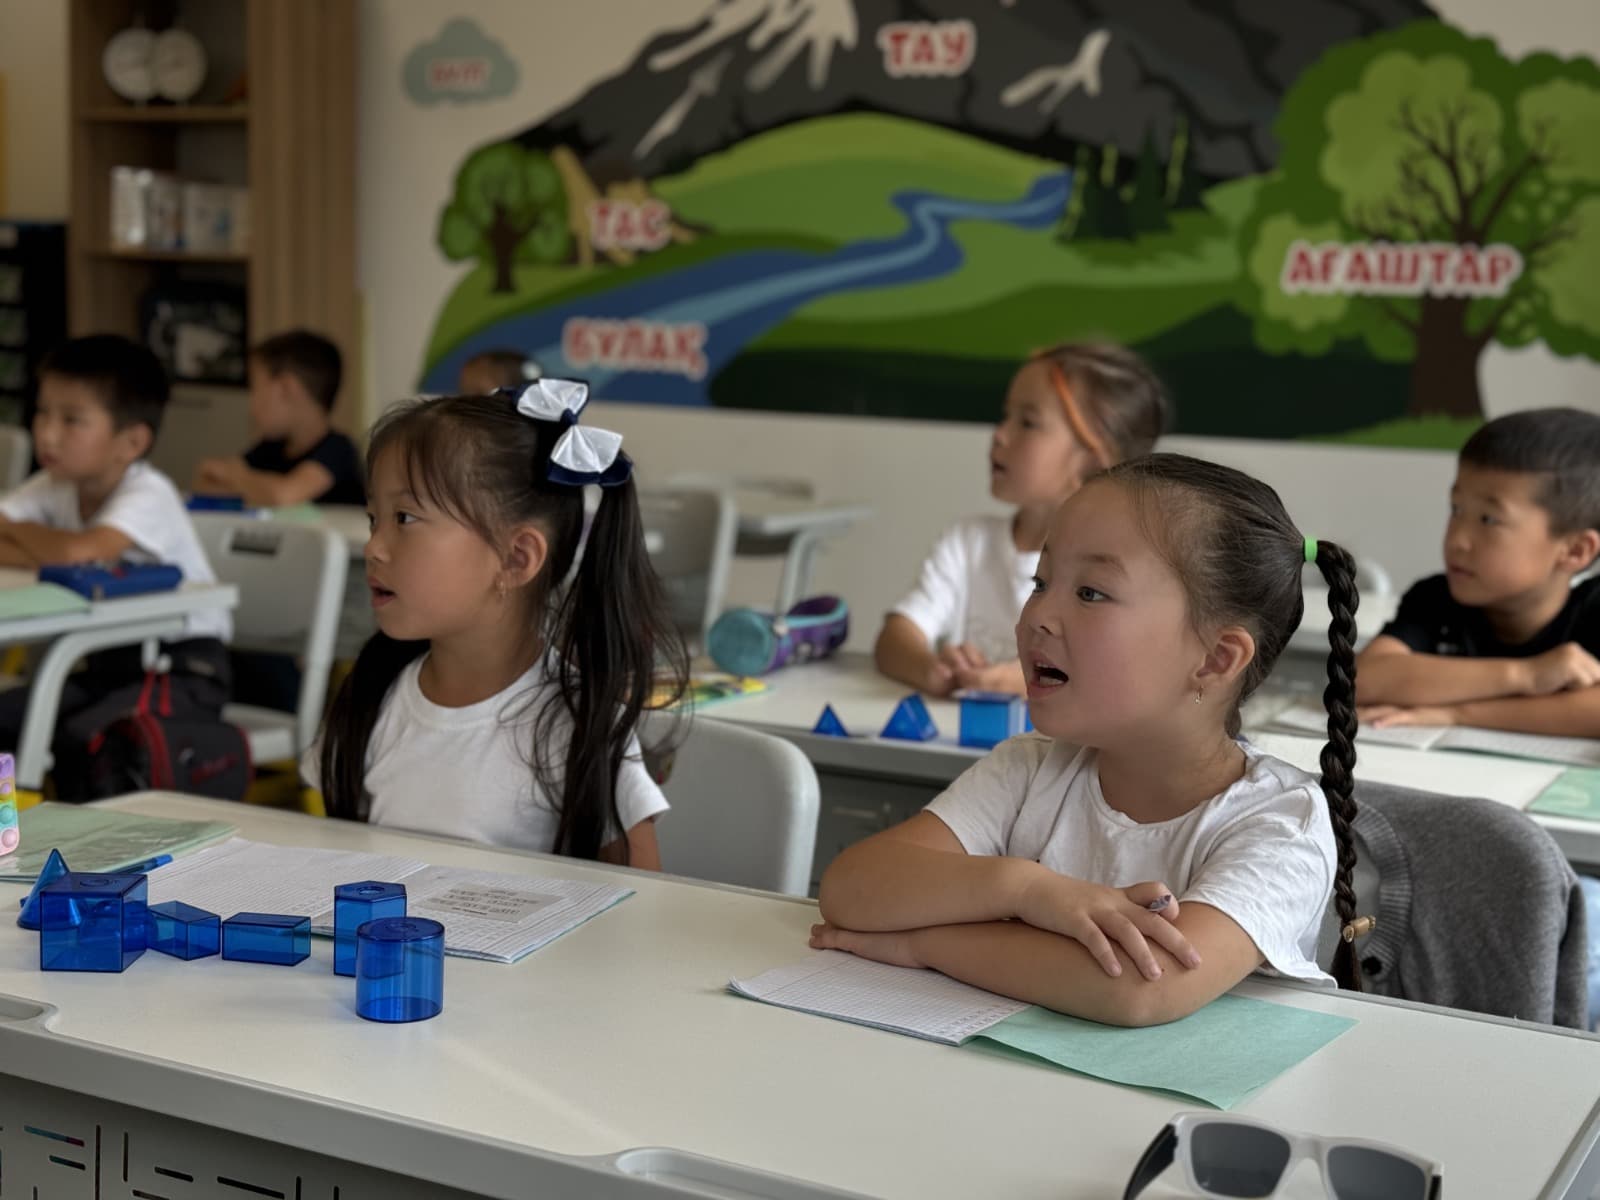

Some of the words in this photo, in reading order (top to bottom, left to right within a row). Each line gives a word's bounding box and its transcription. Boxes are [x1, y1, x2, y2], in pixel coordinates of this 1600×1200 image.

[884, 25, 972, 72] ТАУ
[589, 200, 668, 246] ТАС
[1285, 244, 1517, 290] АҒАШТАР
